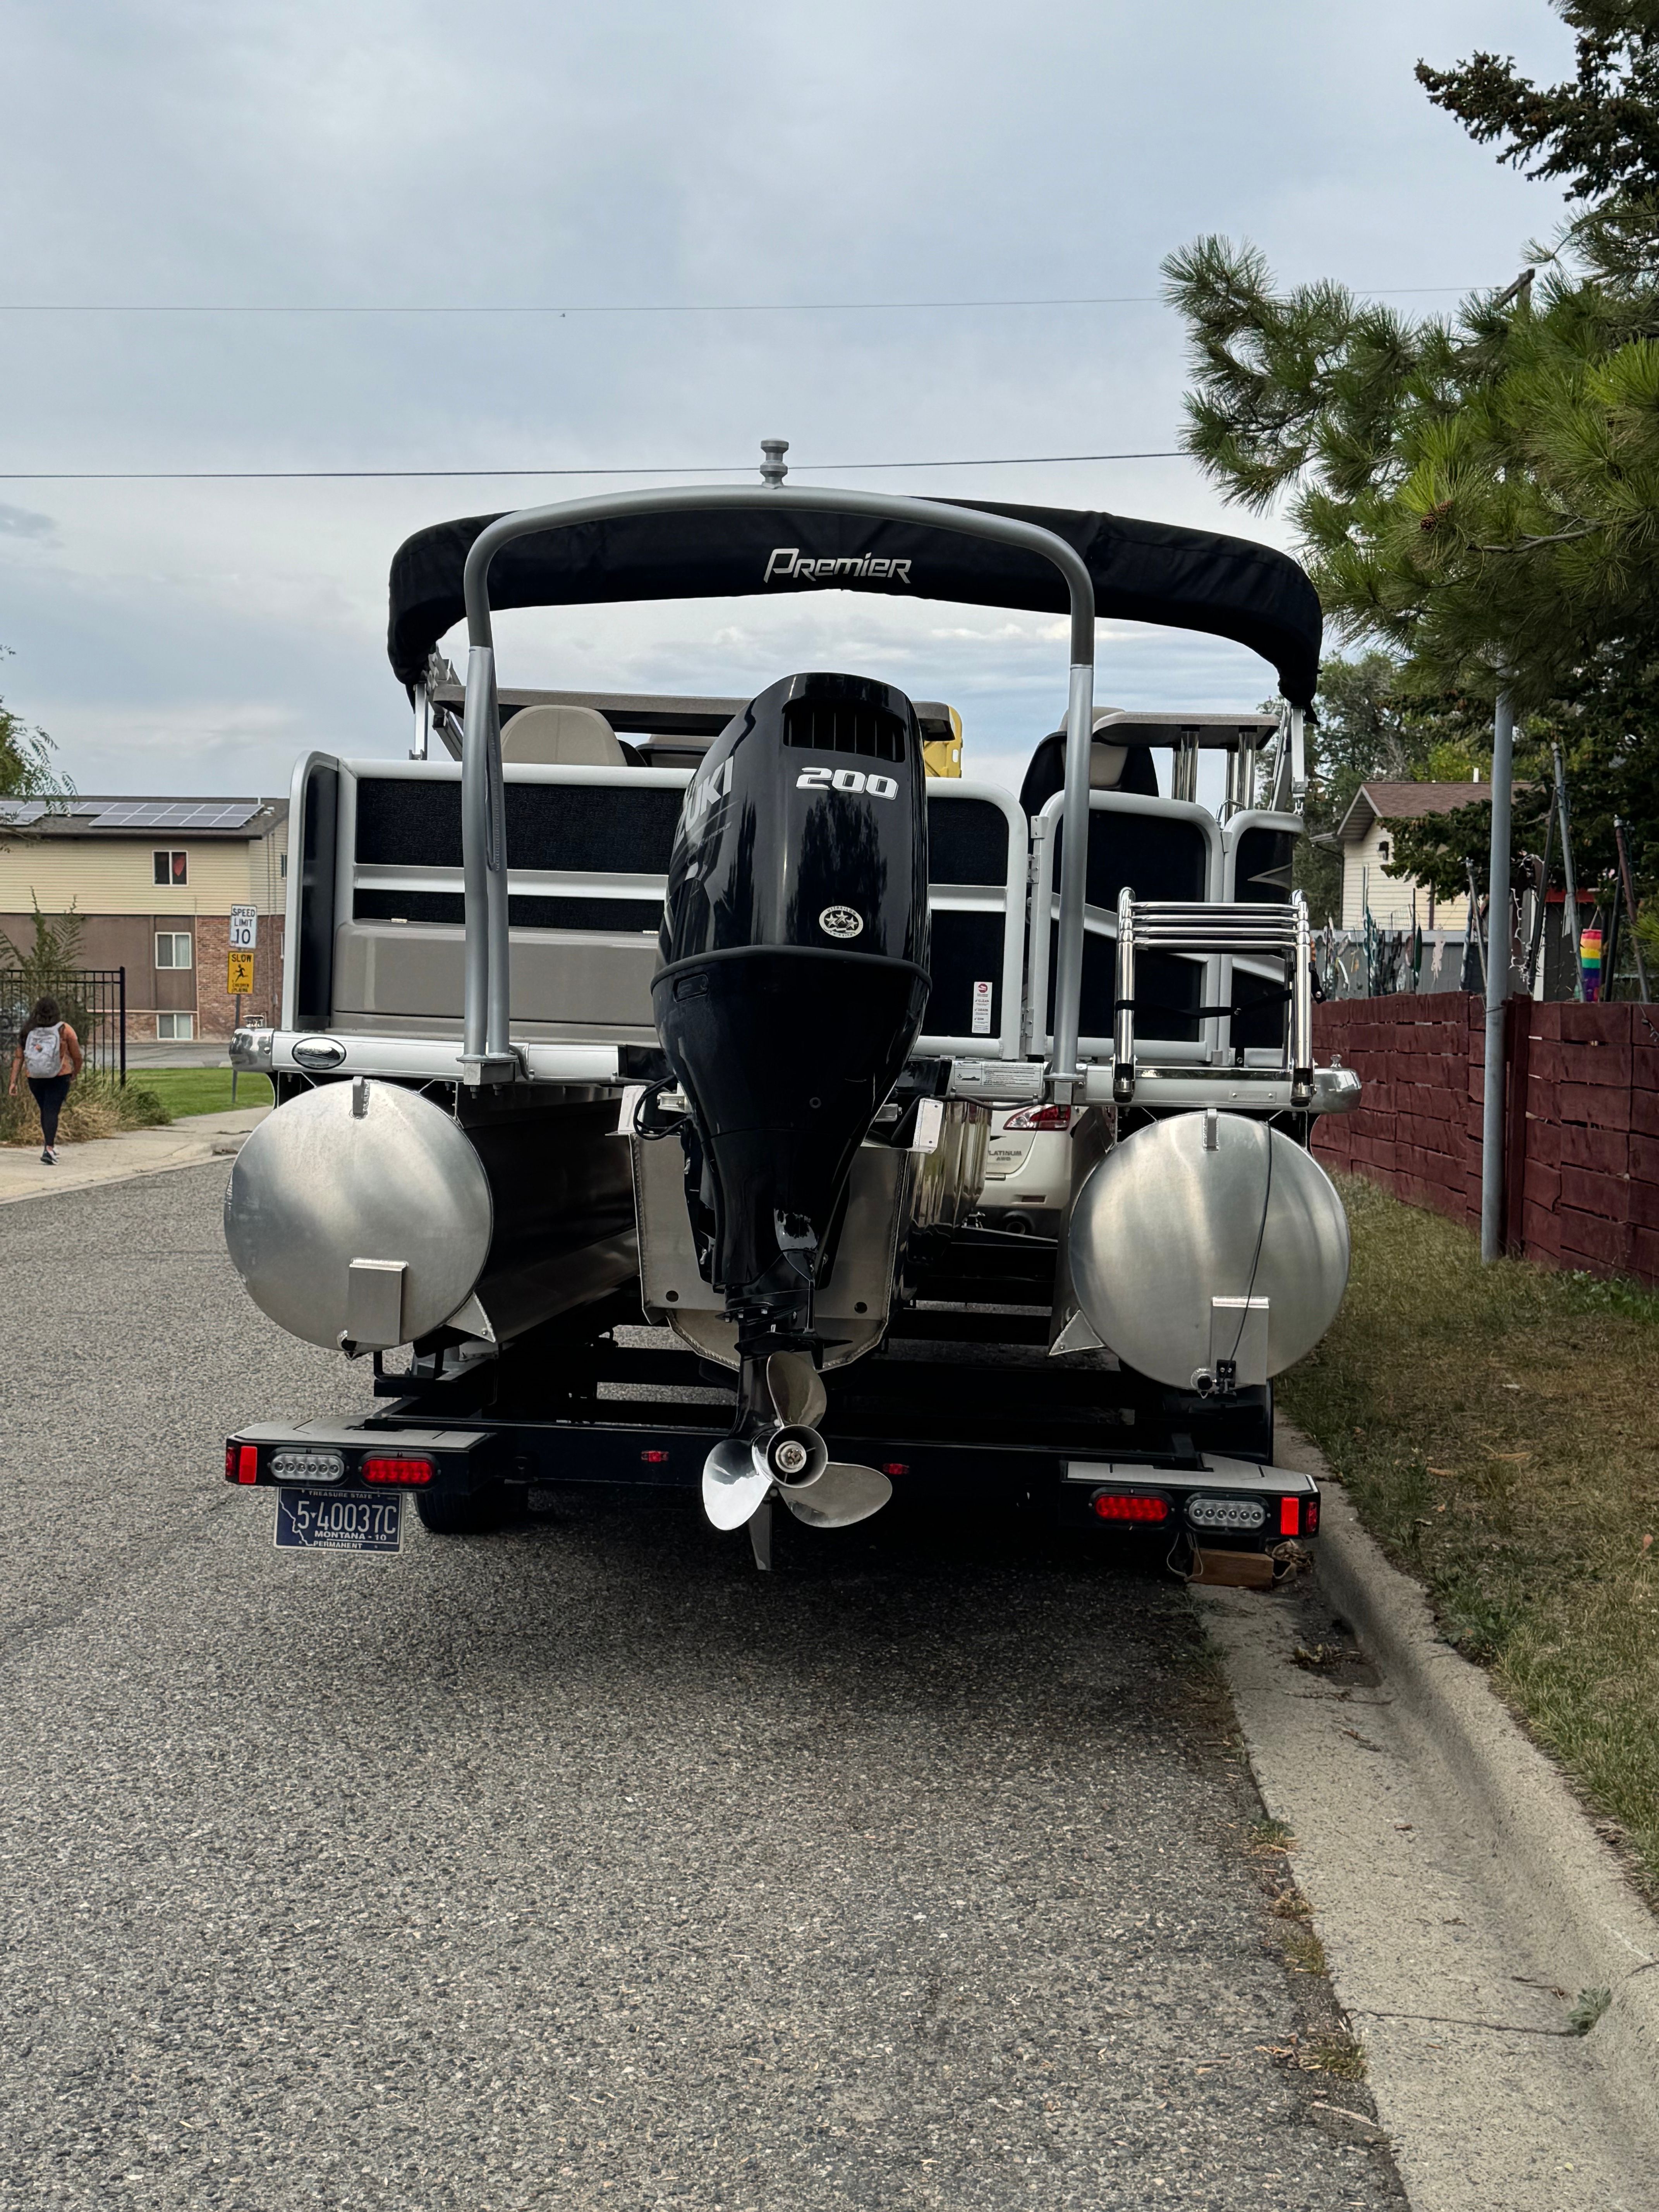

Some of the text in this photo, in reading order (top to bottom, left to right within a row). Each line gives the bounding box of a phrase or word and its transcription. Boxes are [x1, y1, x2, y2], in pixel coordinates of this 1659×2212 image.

[796, 767, 899, 800] 200
[232, 908, 255, 917] SPEED
[234, 918, 252, 927] LIMIT
[236, 929, 251, 944] 10
[232, 954, 252, 962] SLOW
[314, 1530, 366, 1540] MONTANA
